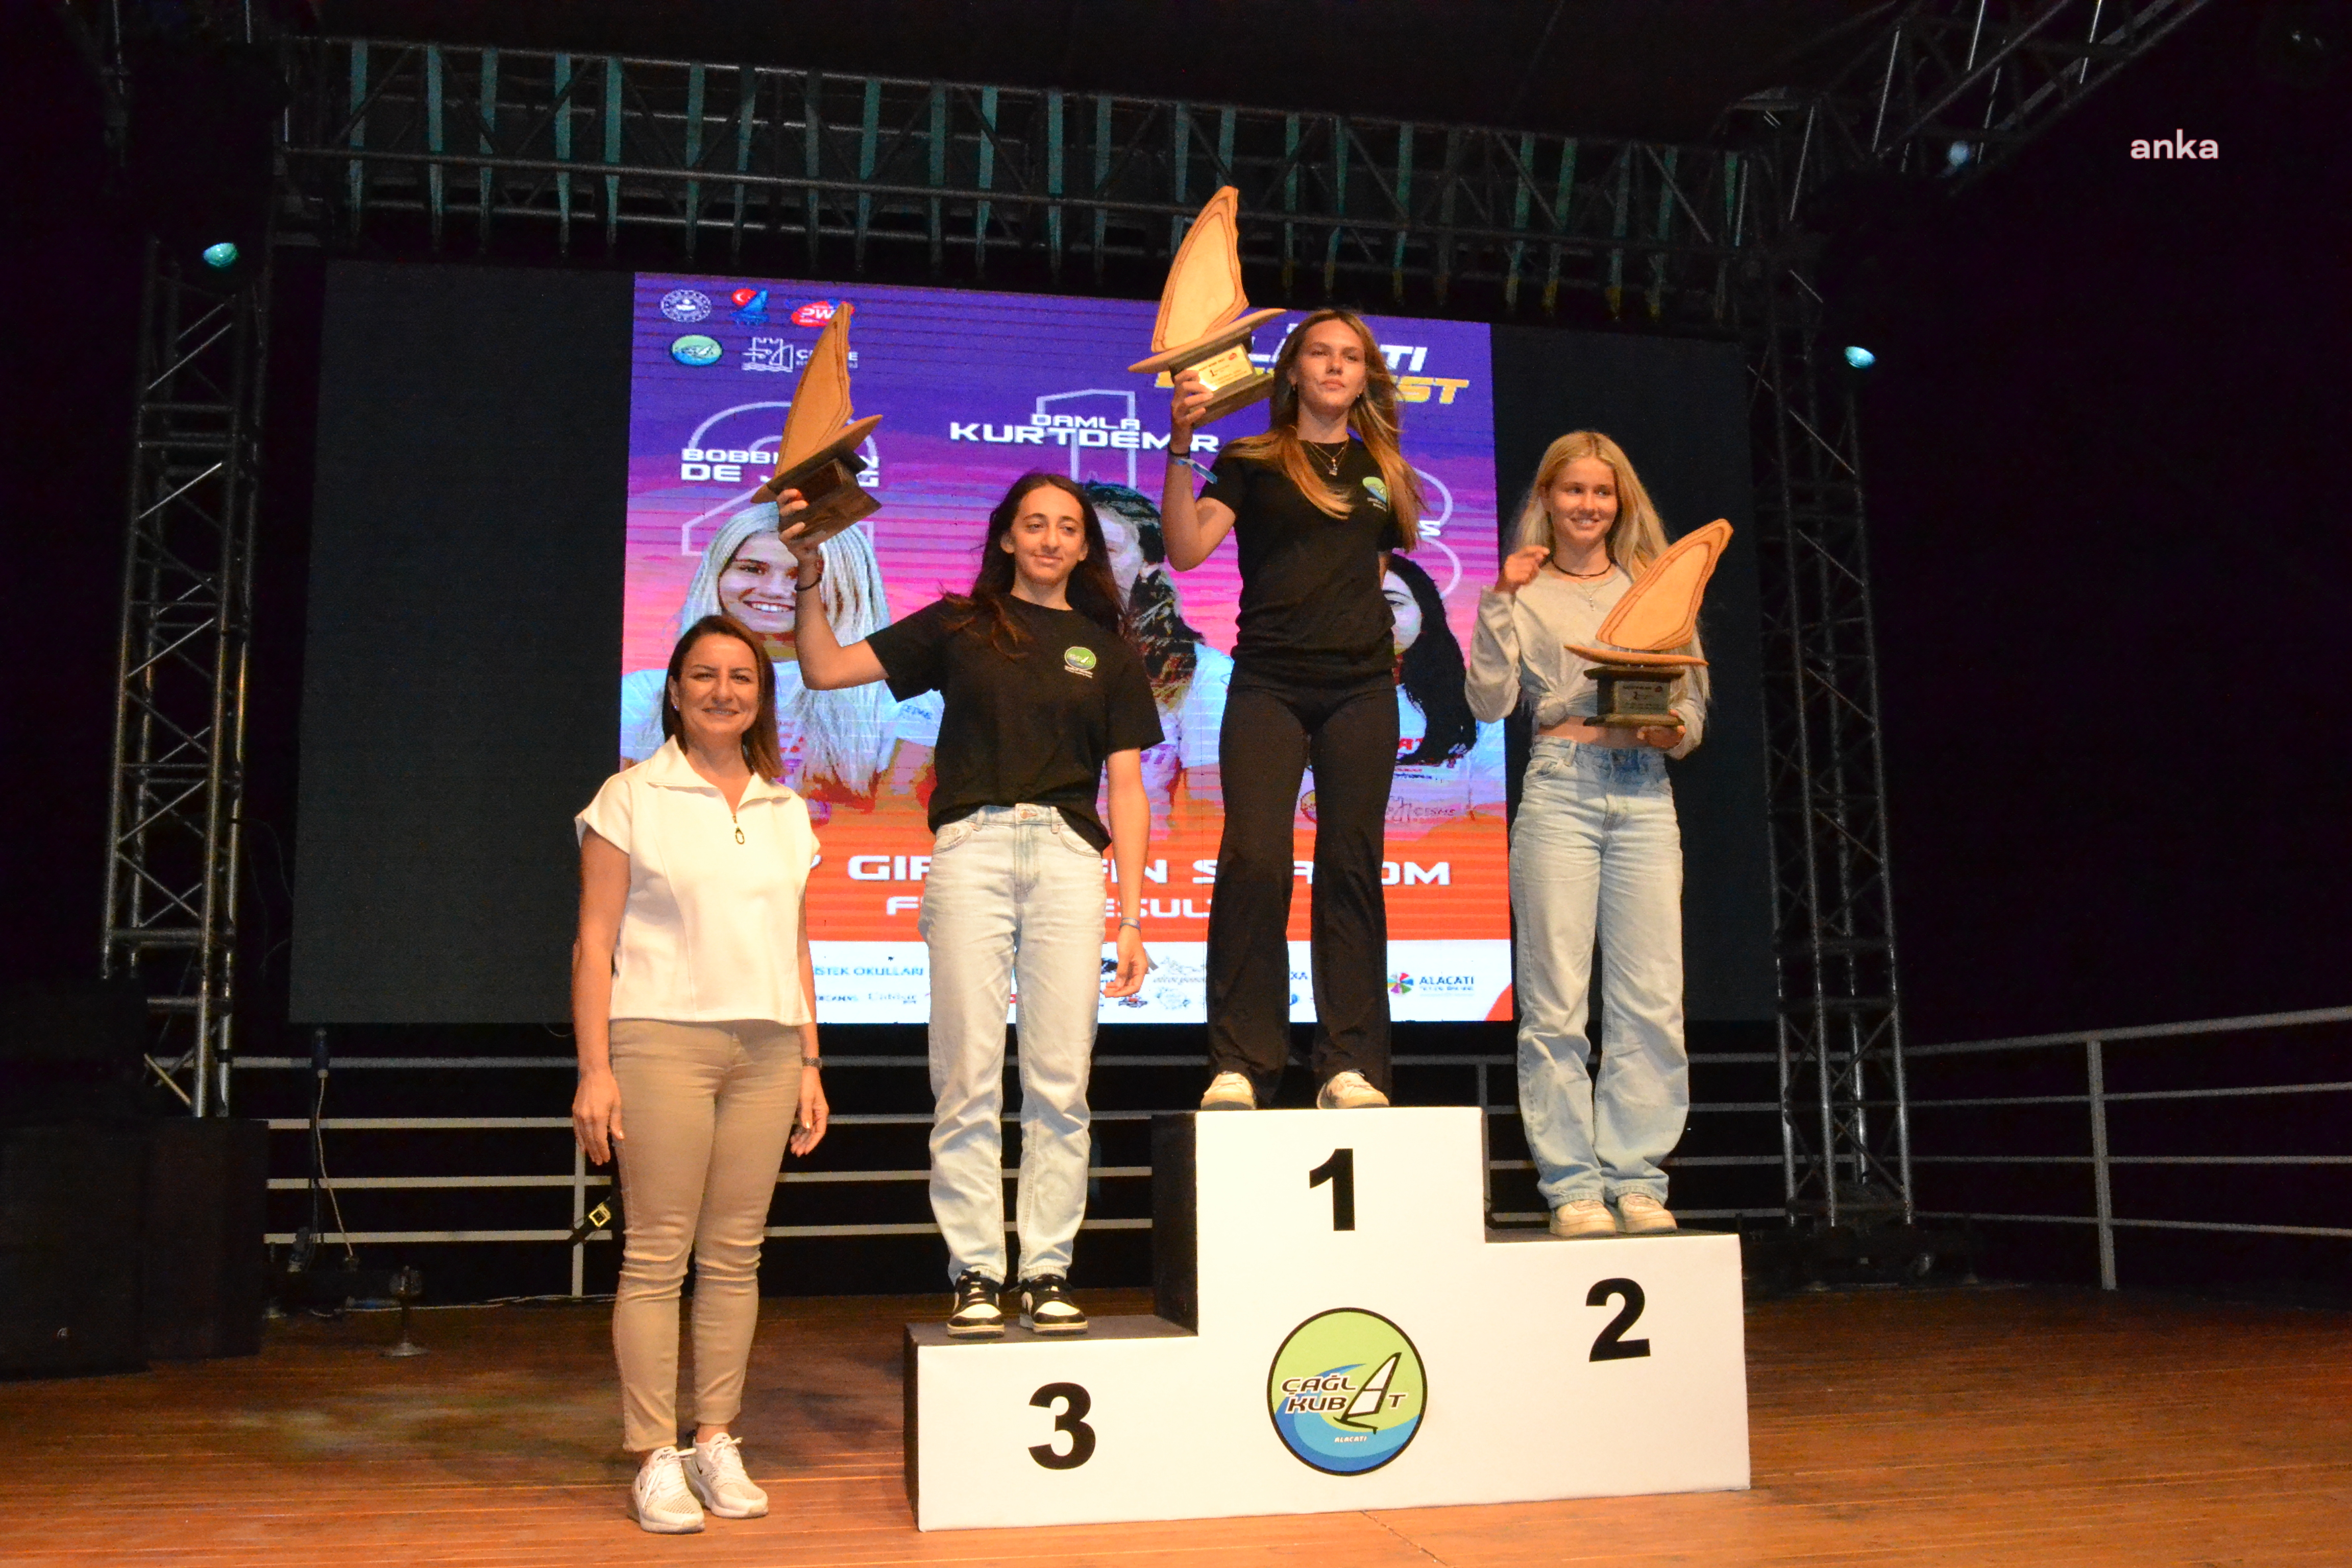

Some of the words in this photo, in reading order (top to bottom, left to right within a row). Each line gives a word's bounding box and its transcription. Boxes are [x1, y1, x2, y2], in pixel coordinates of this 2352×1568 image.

[950, 422, 1220, 452] KURTDEMR
[1030, 413, 1140, 431] DAMLA
[680, 463, 742, 482] DE
[1309, 1148, 1355, 1231] 1
[1585, 1278, 1651, 1362] 2
[1027, 1382, 1096, 1470] 3
